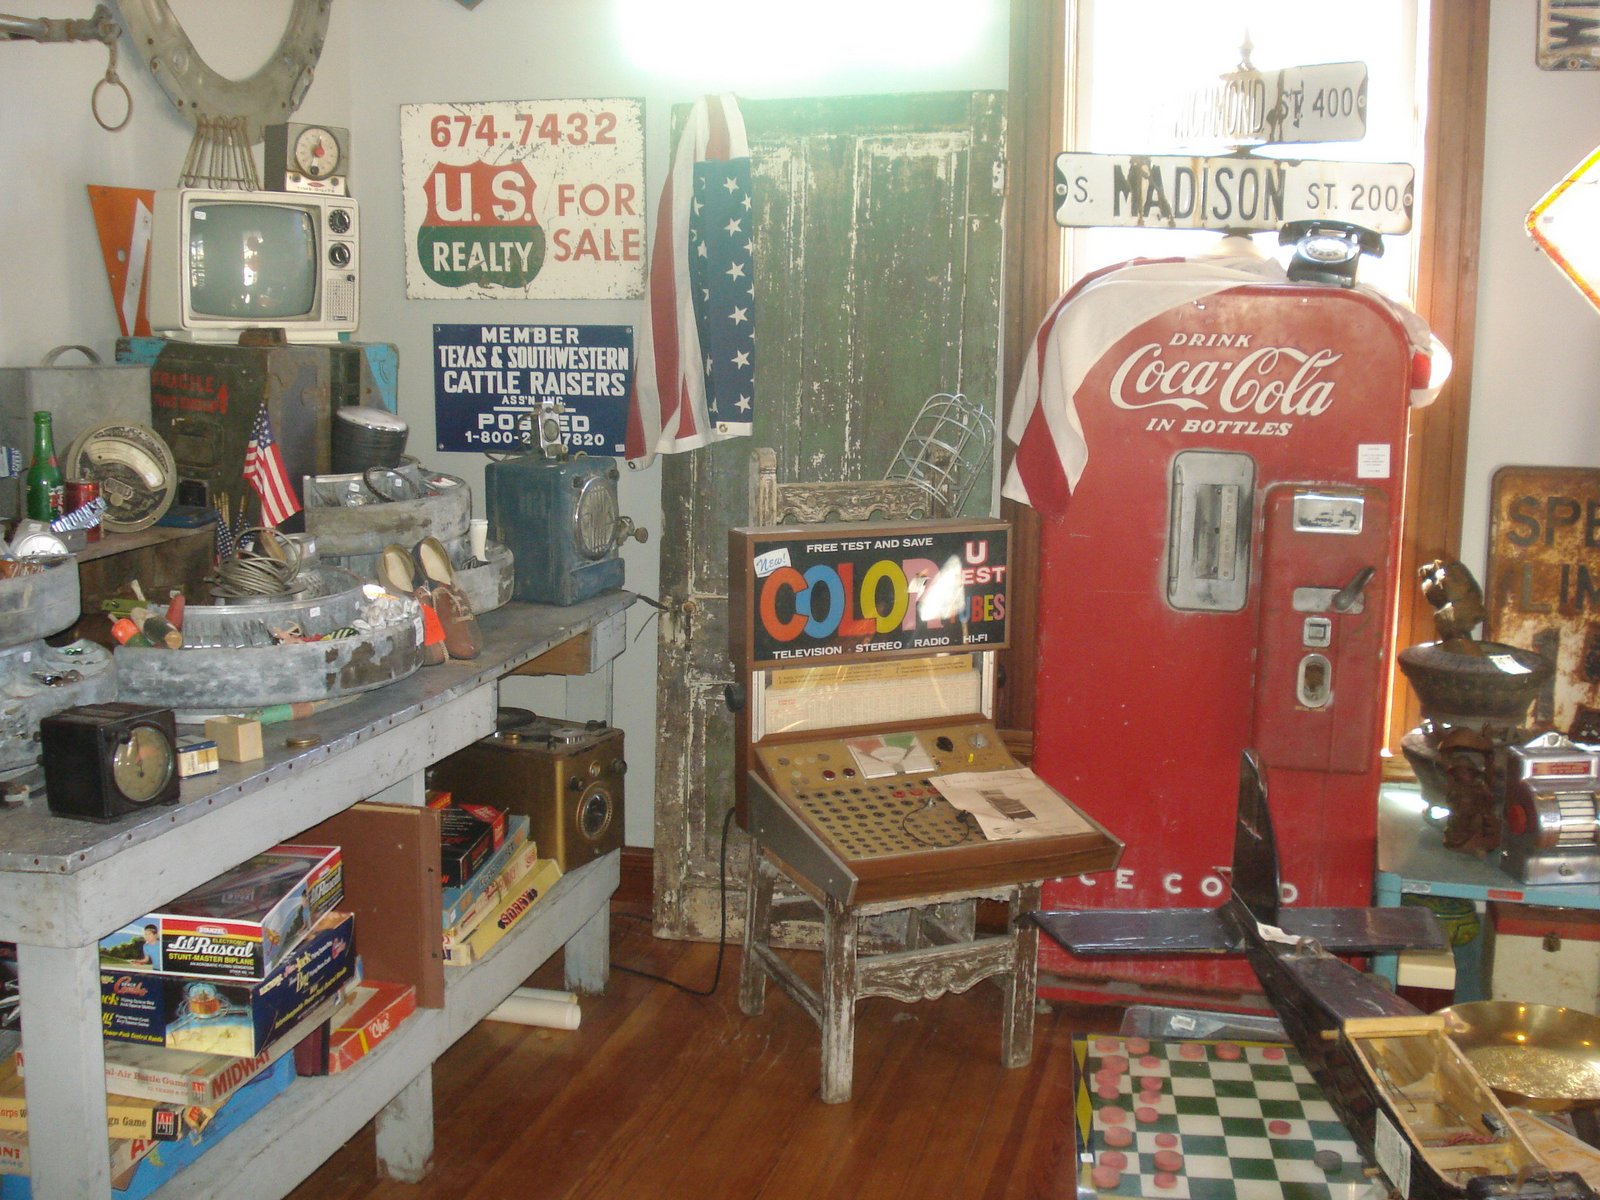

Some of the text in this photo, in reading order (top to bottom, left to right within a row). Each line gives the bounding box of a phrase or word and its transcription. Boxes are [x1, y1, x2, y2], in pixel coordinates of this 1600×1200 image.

[1312, 87, 1353, 118] 400
[430, 111, 617, 148] 674-7432
[558, 183, 636, 217] FOR
[1112, 163, 1286, 222] MADISON
[1306, 183, 1338, 211] ST.
[1351, 184, 1398, 212] 200
[433, 241, 533, 273] REALTY
[553, 229, 641, 262] SALE
[481, 326, 579, 344] MEMBER
[1169, 332, 1253, 348] DRINK
[438, 345, 629, 371] TEXAS & SOUTHWESTERN
[443, 370, 626, 397] CATTLE RAISERS
[1110, 343, 1343, 416] Coca-Cola
[502, 395, 536, 405] ASS'N
[478, 413, 590, 433] POSED
[1146, 417, 1293, 436] IN BOTTLES
[806, 537, 934, 554] FREE TEST AND SAVE
[965, 541, 988, 565] U
[960, 565, 1007, 586] EST
[760, 558, 944, 643] COLOR
[949, 593, 1006, 624] UBES
[772, 633, 988, 660] TELEVISION STEREO RADIO HI-FI
[1163, 872, 1298, 903] COD
[168, 952, 255, 966] STUNT-MASTER BIPLANE
[122, 1116, 147, 1128] Game
